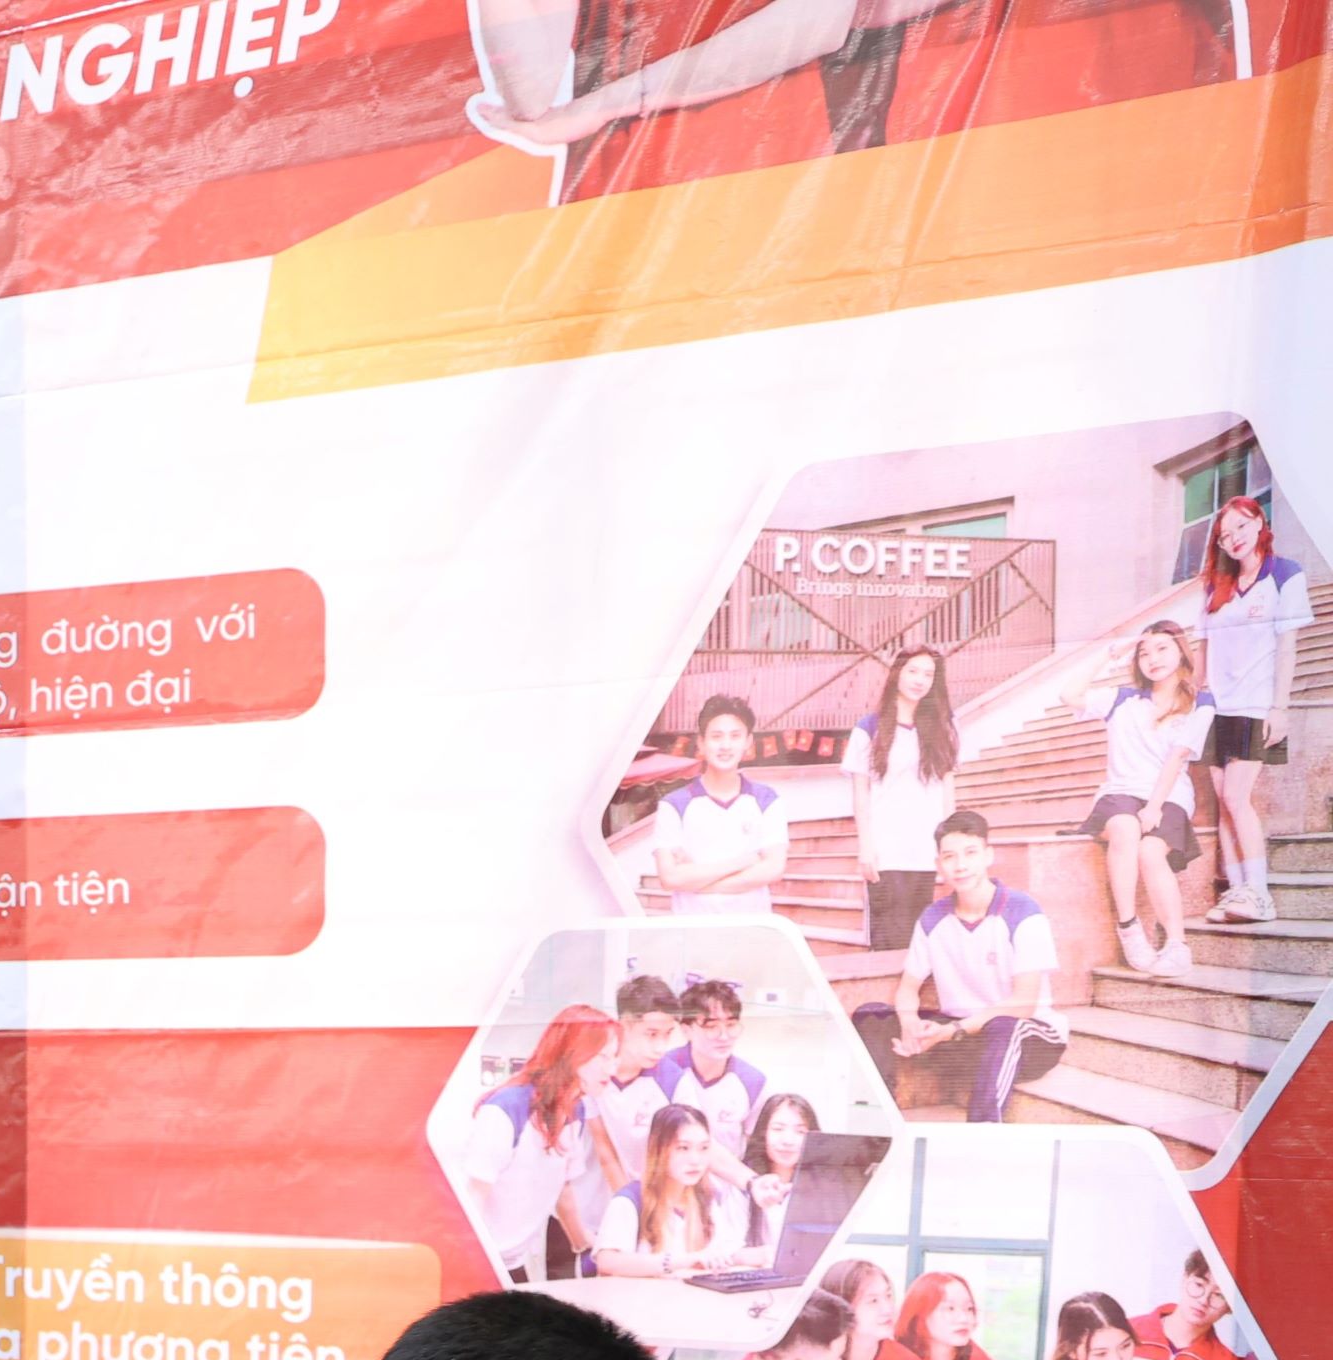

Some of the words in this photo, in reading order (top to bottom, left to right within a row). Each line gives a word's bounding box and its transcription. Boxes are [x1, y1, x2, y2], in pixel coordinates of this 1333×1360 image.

[774, 536, 801, 573] P.
[811, 537, 972, 578] COFFEE
[796, 577, 852, 598] Brings
[856, 580, 948, 597] innovation
[41, 614, 172, 657] đường
[194, 603, 255, 643] với
[30, 675, 113, 720] hiện
[125, 668, 191, 714] đại
[54, 870, 130, 915] tiện
[159, 1261, 313, 1323] thông
